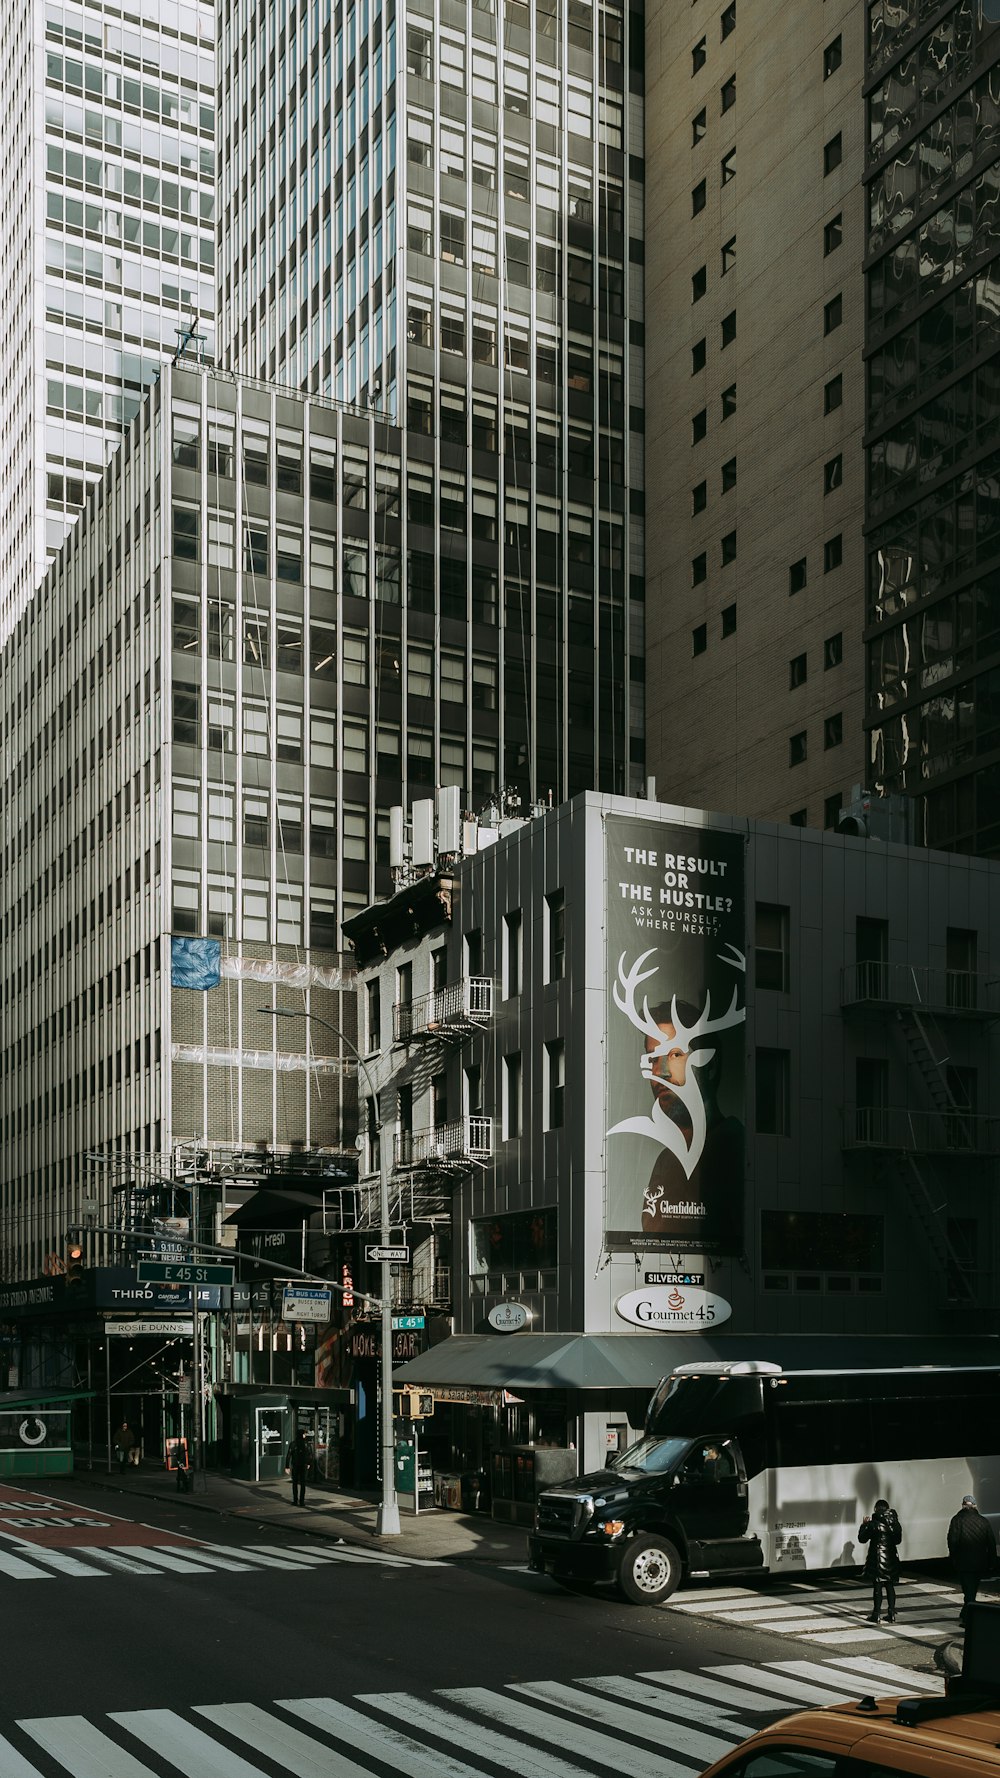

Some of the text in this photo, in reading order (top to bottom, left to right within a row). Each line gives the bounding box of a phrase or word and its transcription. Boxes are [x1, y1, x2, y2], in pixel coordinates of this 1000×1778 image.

[624, 847, 727, 876] THE RESULT
[664, 872, 688, 889] OR
[619, 882, 733, 913] THE HUSTLE?
[631, 906, 722, 927] ASK YOURSELF,
[635, 917, 718, 936] WHERE NEXT?
[660, 1200, 706, 1215] Glenfiddich
[264, 1232, 286, 1247] Fresh
[161, 1254, 186, 1262] NEVER
[165, 1266, 208, 1281] E 45 St
[112, 1290, 153, 1299] THIRD
[636, 1302, 715, 1321] Gourmet 45
[399, 1318, 404, 1327] E
[406, 1318, 416, 1327] 45
[0, 1517, 112, 1528] BUS
